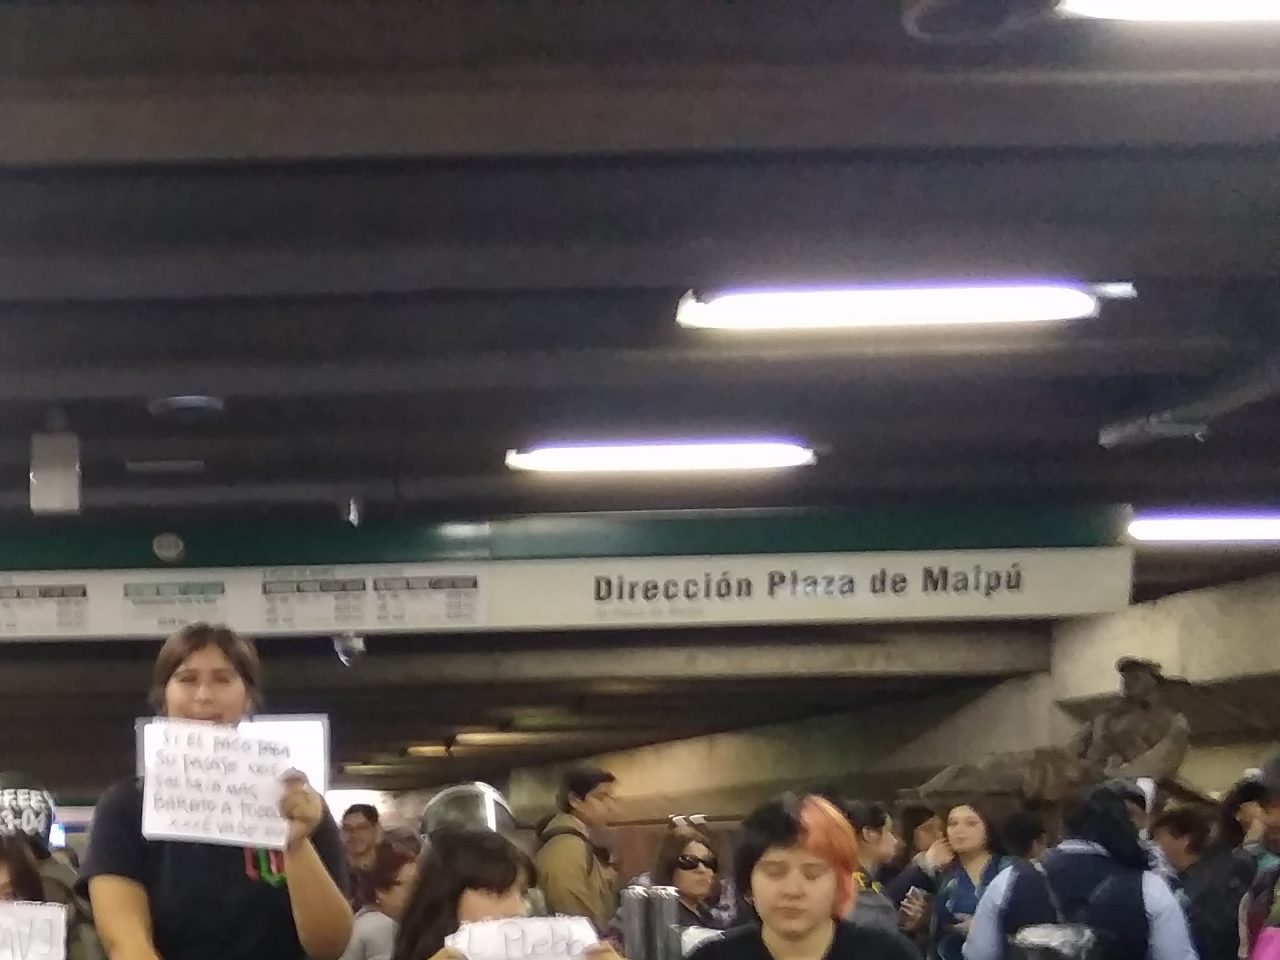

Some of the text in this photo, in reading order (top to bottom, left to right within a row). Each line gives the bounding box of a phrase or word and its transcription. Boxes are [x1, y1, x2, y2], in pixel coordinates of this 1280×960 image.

[593, 562, 1023, 603] Dirección Plaza de Maipú
